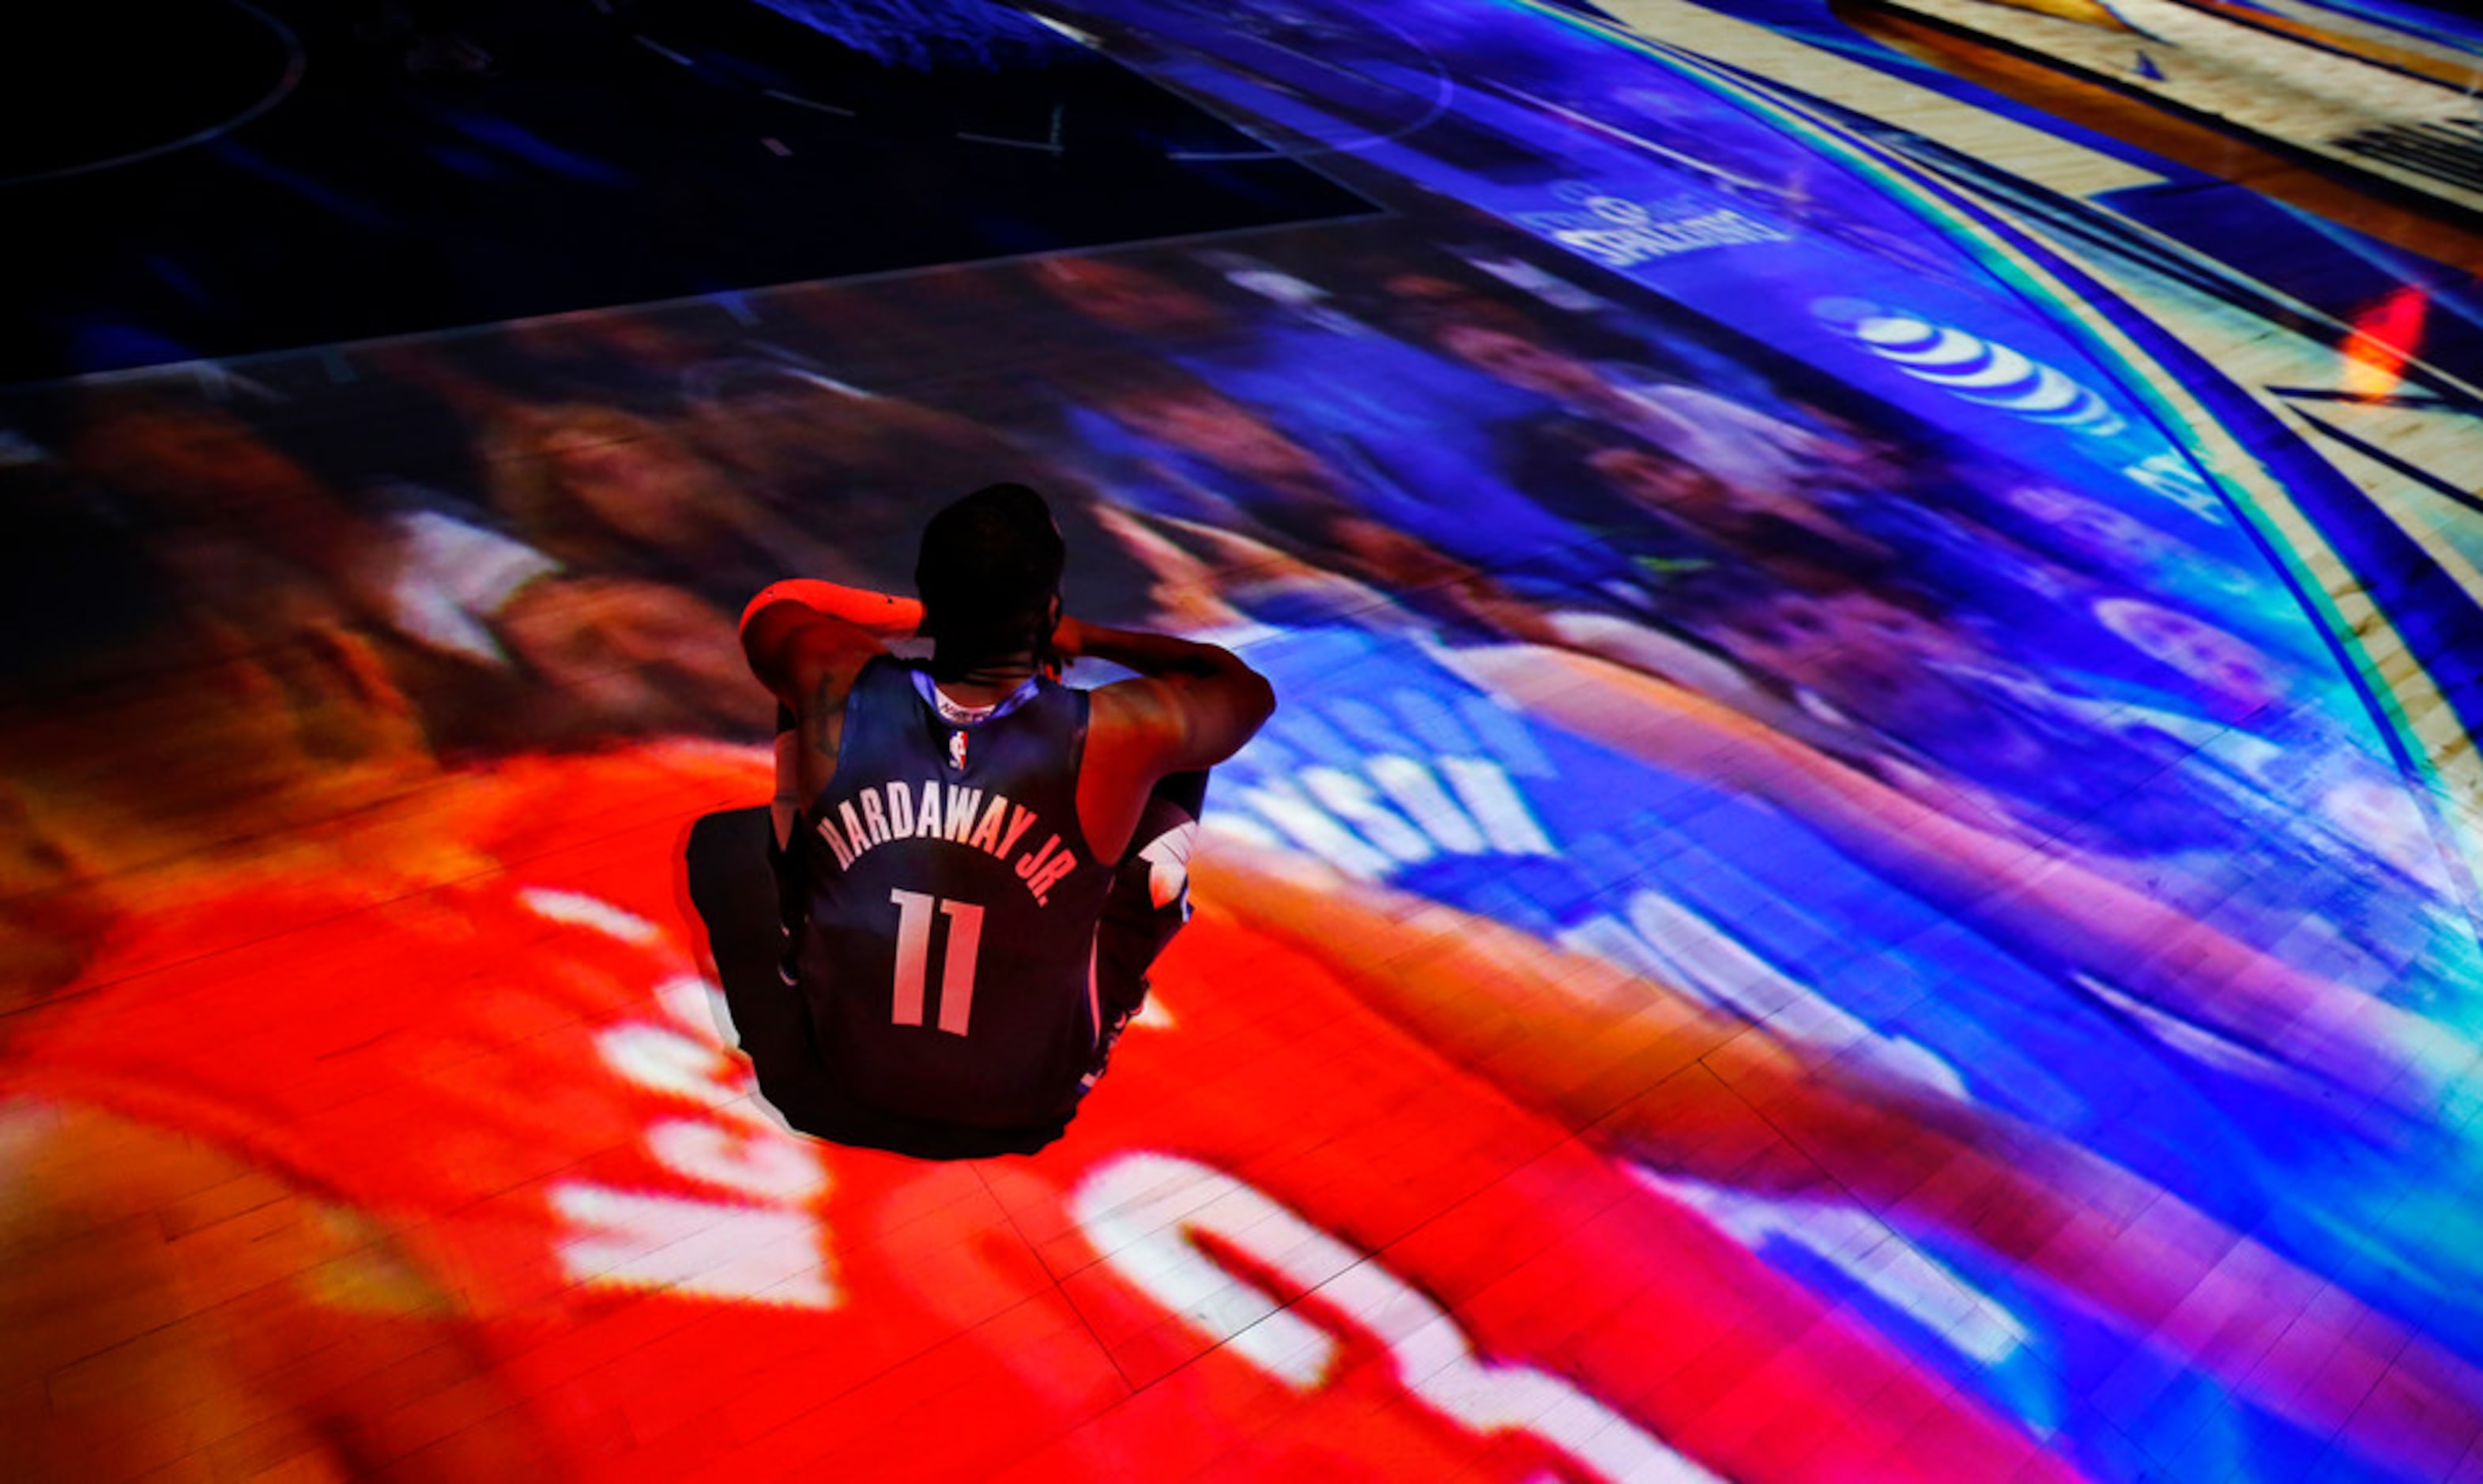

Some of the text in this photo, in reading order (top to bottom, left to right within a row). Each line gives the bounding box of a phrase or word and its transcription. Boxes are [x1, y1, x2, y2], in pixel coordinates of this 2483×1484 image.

[817, 781, 1078, 907] HARDAWAY JR.
[890, 887, 985, 1038] 11
